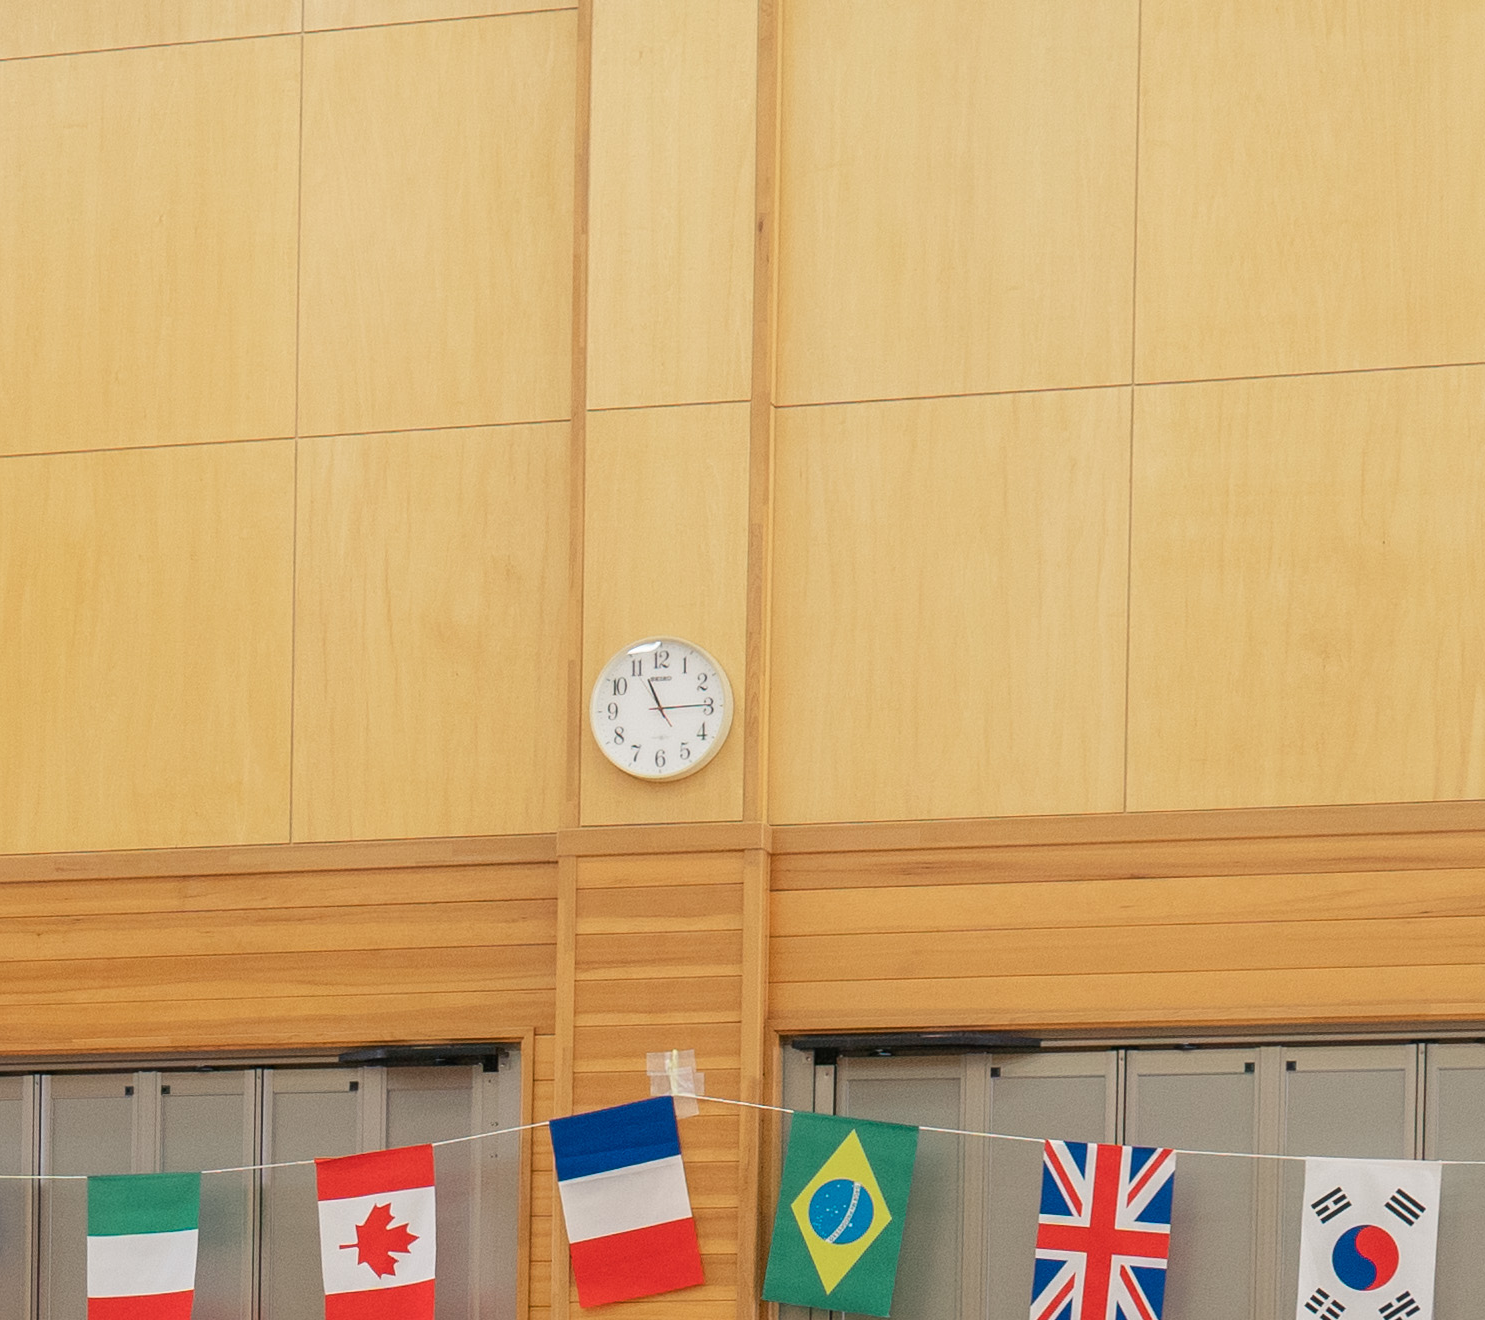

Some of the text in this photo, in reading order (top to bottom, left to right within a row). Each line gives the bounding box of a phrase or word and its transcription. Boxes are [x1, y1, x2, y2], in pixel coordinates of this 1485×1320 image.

[631, 659, 643, 677] 11
[653, 650, 670, 669] 12
[682, 656, 688, 675] 1
[612, 676, 628, 696] 10
[696, 672, 709, 692] 2
[607, 702, 619, 720] 9
[703, 696, 714, 716] 3
[614, 726, 625, 745] 8
[696, 721, 708, 741] 4
[631, 744, 642, 762] 7
[654, 749, 666, 768] 6
[680, 742, 691, 760] 5
